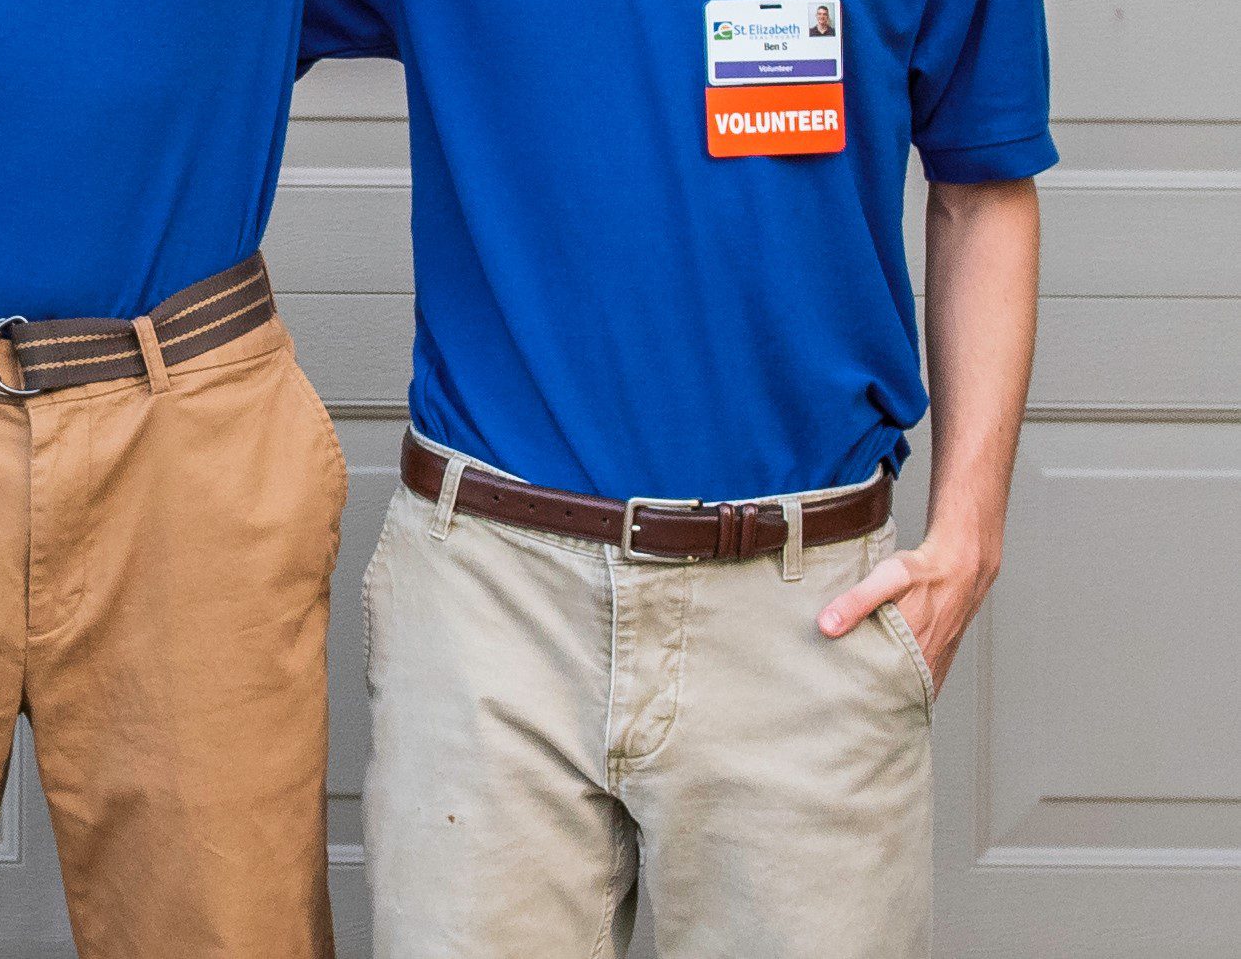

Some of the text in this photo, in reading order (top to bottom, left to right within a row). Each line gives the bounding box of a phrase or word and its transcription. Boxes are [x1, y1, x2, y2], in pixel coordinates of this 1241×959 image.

[734, 24, 800, 36] St Elizabeth
[764, 42, 788, 51] Ben S
[714, 109, 839, 135] VOLUNTEER
